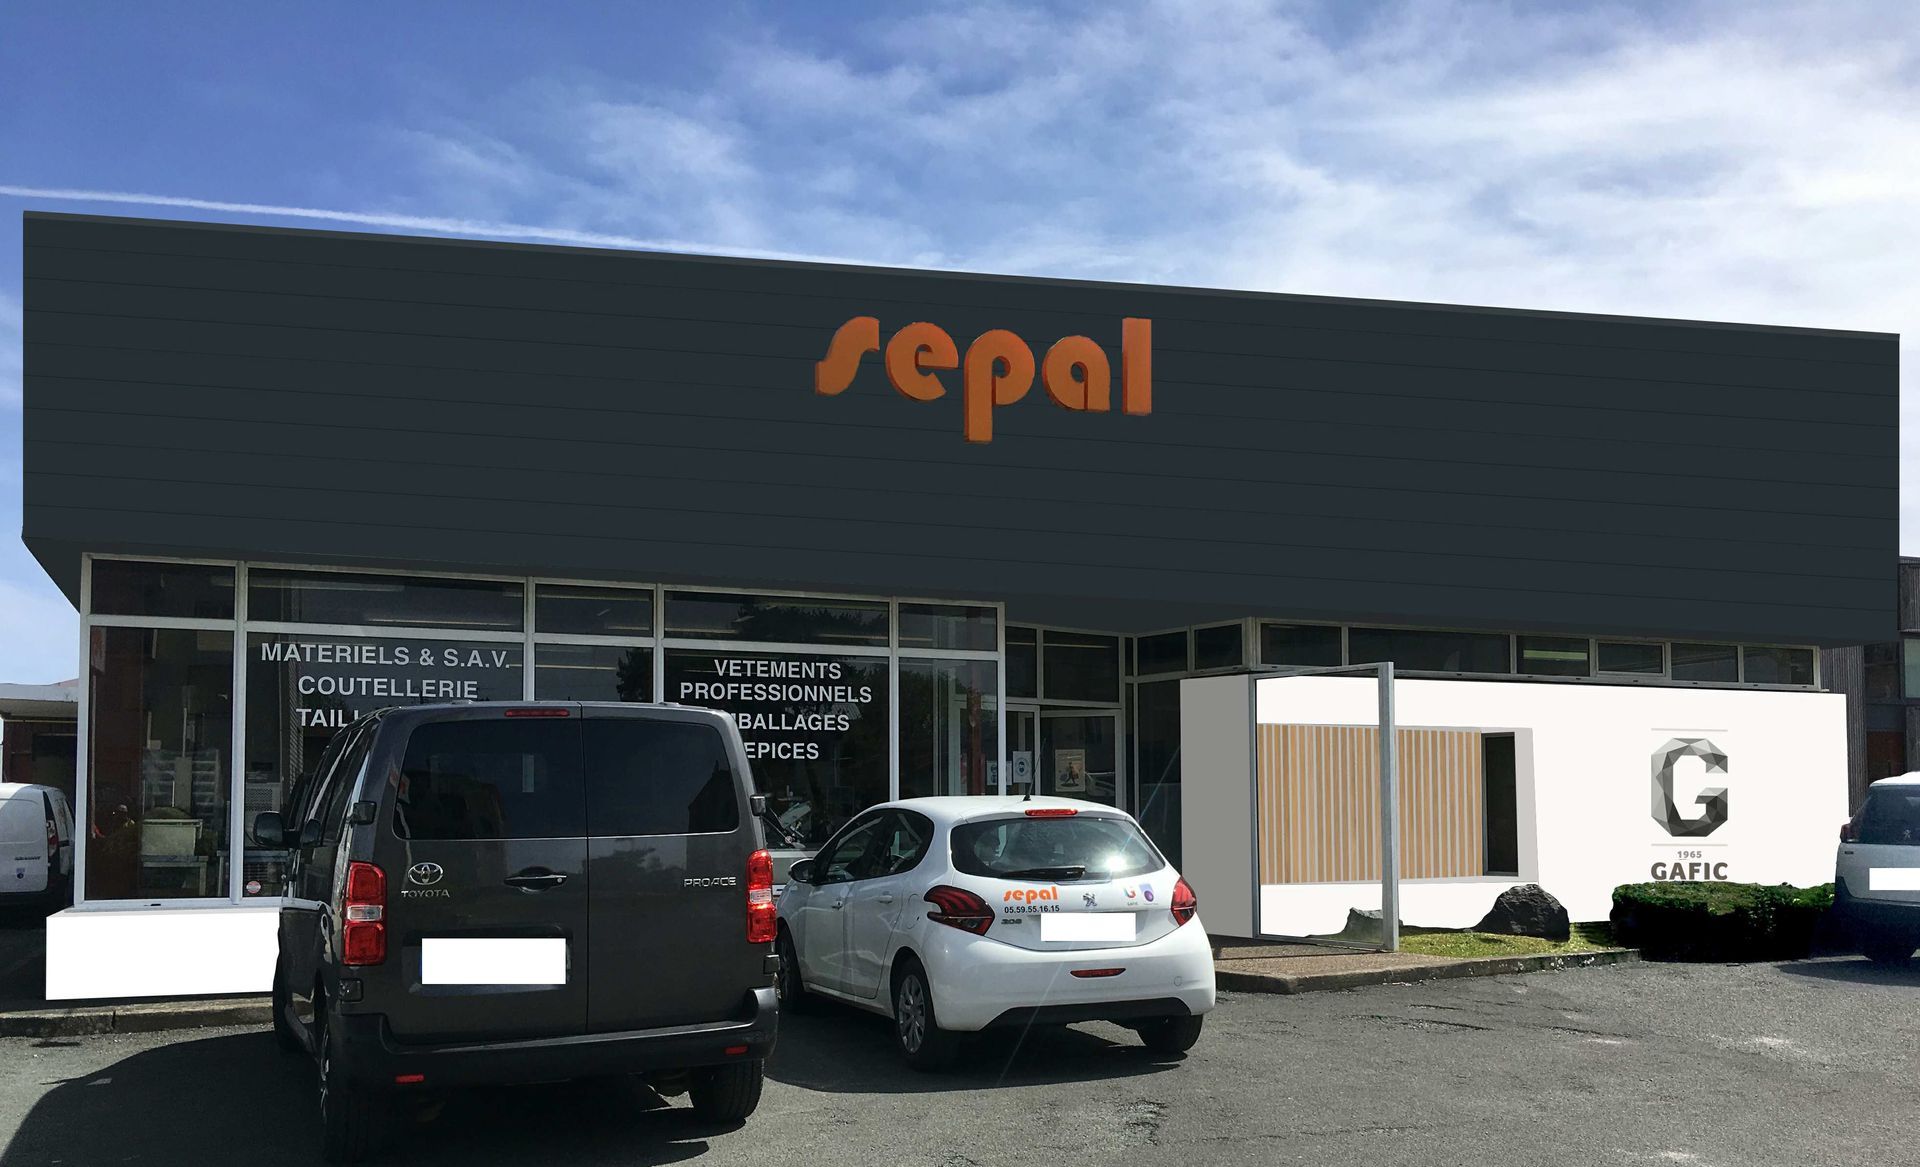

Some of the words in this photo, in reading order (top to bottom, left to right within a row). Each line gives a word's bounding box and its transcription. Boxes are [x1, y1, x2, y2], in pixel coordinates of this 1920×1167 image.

[815, 316, 1153, 444] sepal
[261, 642, 410, 666] MATERIELS
[419, 648, 435, 666] &
[443, 648, 511, 669] S.A.V.
[714, 659, 842, 680] VETEMENTS
[298, 675, 479, 699] COUTELLERIE
[680, 682, 873, 704] PROFESSIONNELS
[730, 712, 850, 732] BALLAGES
[743, 742, 820, 760] EPICES
[1677, 850, 1702, 859] 1965
[1651, 862, 1728, 880] GAFIC
[683, 876, 737, 887] PROACE
[401, 889, 450, 898] TOYOTA
[1003, 886, 1058, 905] sepal
[1004, 905, 1060, 914] 05.59.55.16.15
